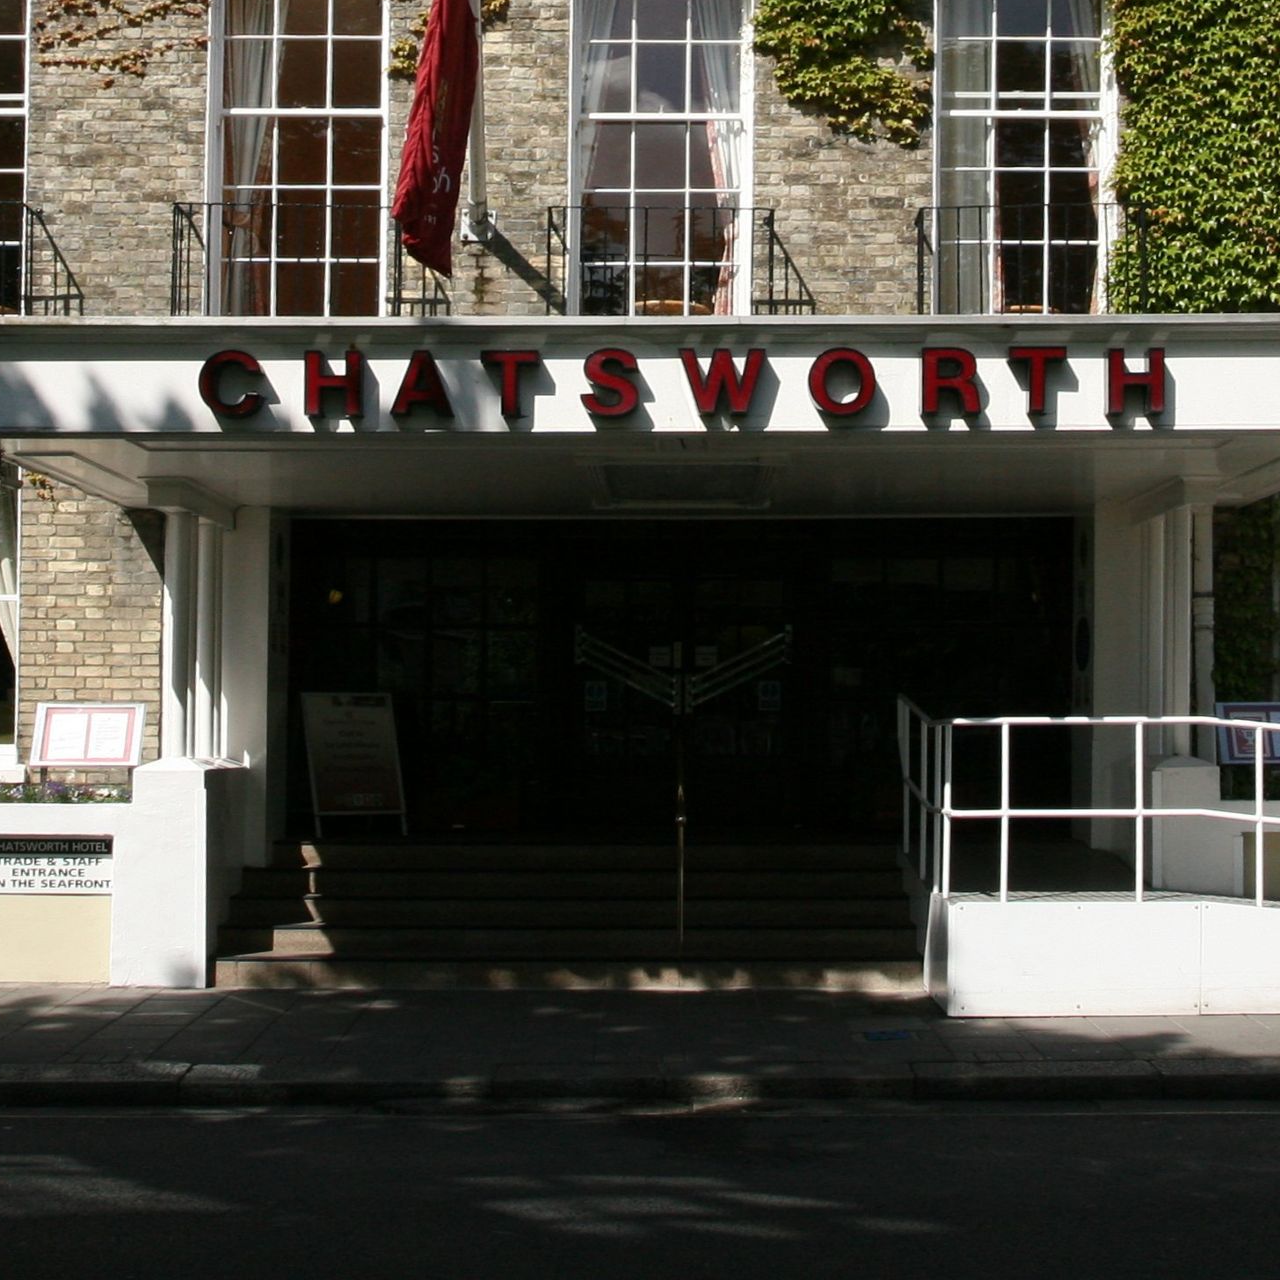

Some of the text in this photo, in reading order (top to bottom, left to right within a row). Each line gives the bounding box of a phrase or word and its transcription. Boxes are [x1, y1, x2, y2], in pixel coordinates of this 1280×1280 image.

[198, 347, 1166, 419] CHATSWORTH
[72, 842, 108, 852] HOTEL
[47, 857, 56, 866] &
[62, 857, 102, 866] STAFF
[12, 868, 85, 877] ENTRANCE
[10, 879, 35, 888] THE
[40, 879, 111, 889] SEAFRONT
